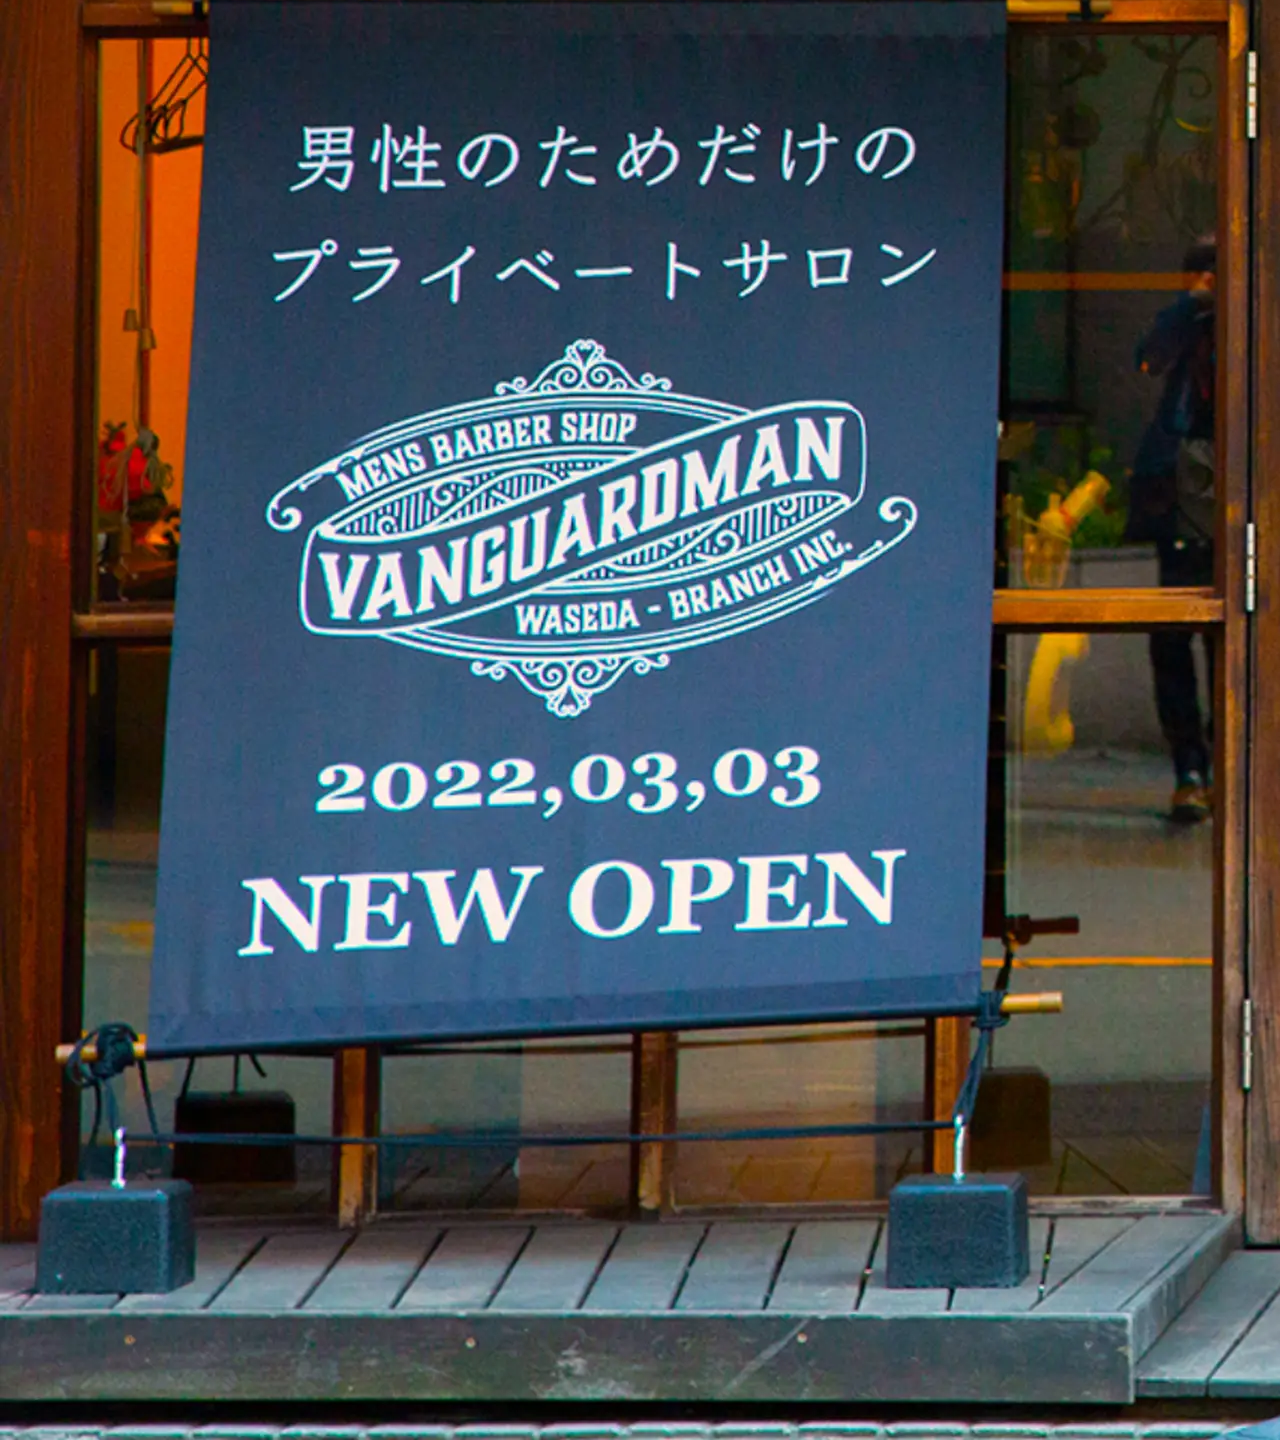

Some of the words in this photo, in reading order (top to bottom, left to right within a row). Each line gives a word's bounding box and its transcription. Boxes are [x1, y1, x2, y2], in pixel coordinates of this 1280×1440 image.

[290, 123, 917, 193] 男性のためだけの
[273, 239, 937, 304] プライベートサロン
[335, 442, 428, 502] MENS
[430, 413, 553, 458] BARBER
[560, 412, 638, 444] SHOP
[317, 417, 847, 622] VANGUARDMAN
[514, 598, 641, 636] WASEDA
[667, 554, 792, 620] BRANCH
[789, 529, 853, 576] INC.
[315, 745, 822, 819] 2022,03,03
[237, 865, 545, 957] NEW
[568, 848, 907, 939] OPEN
